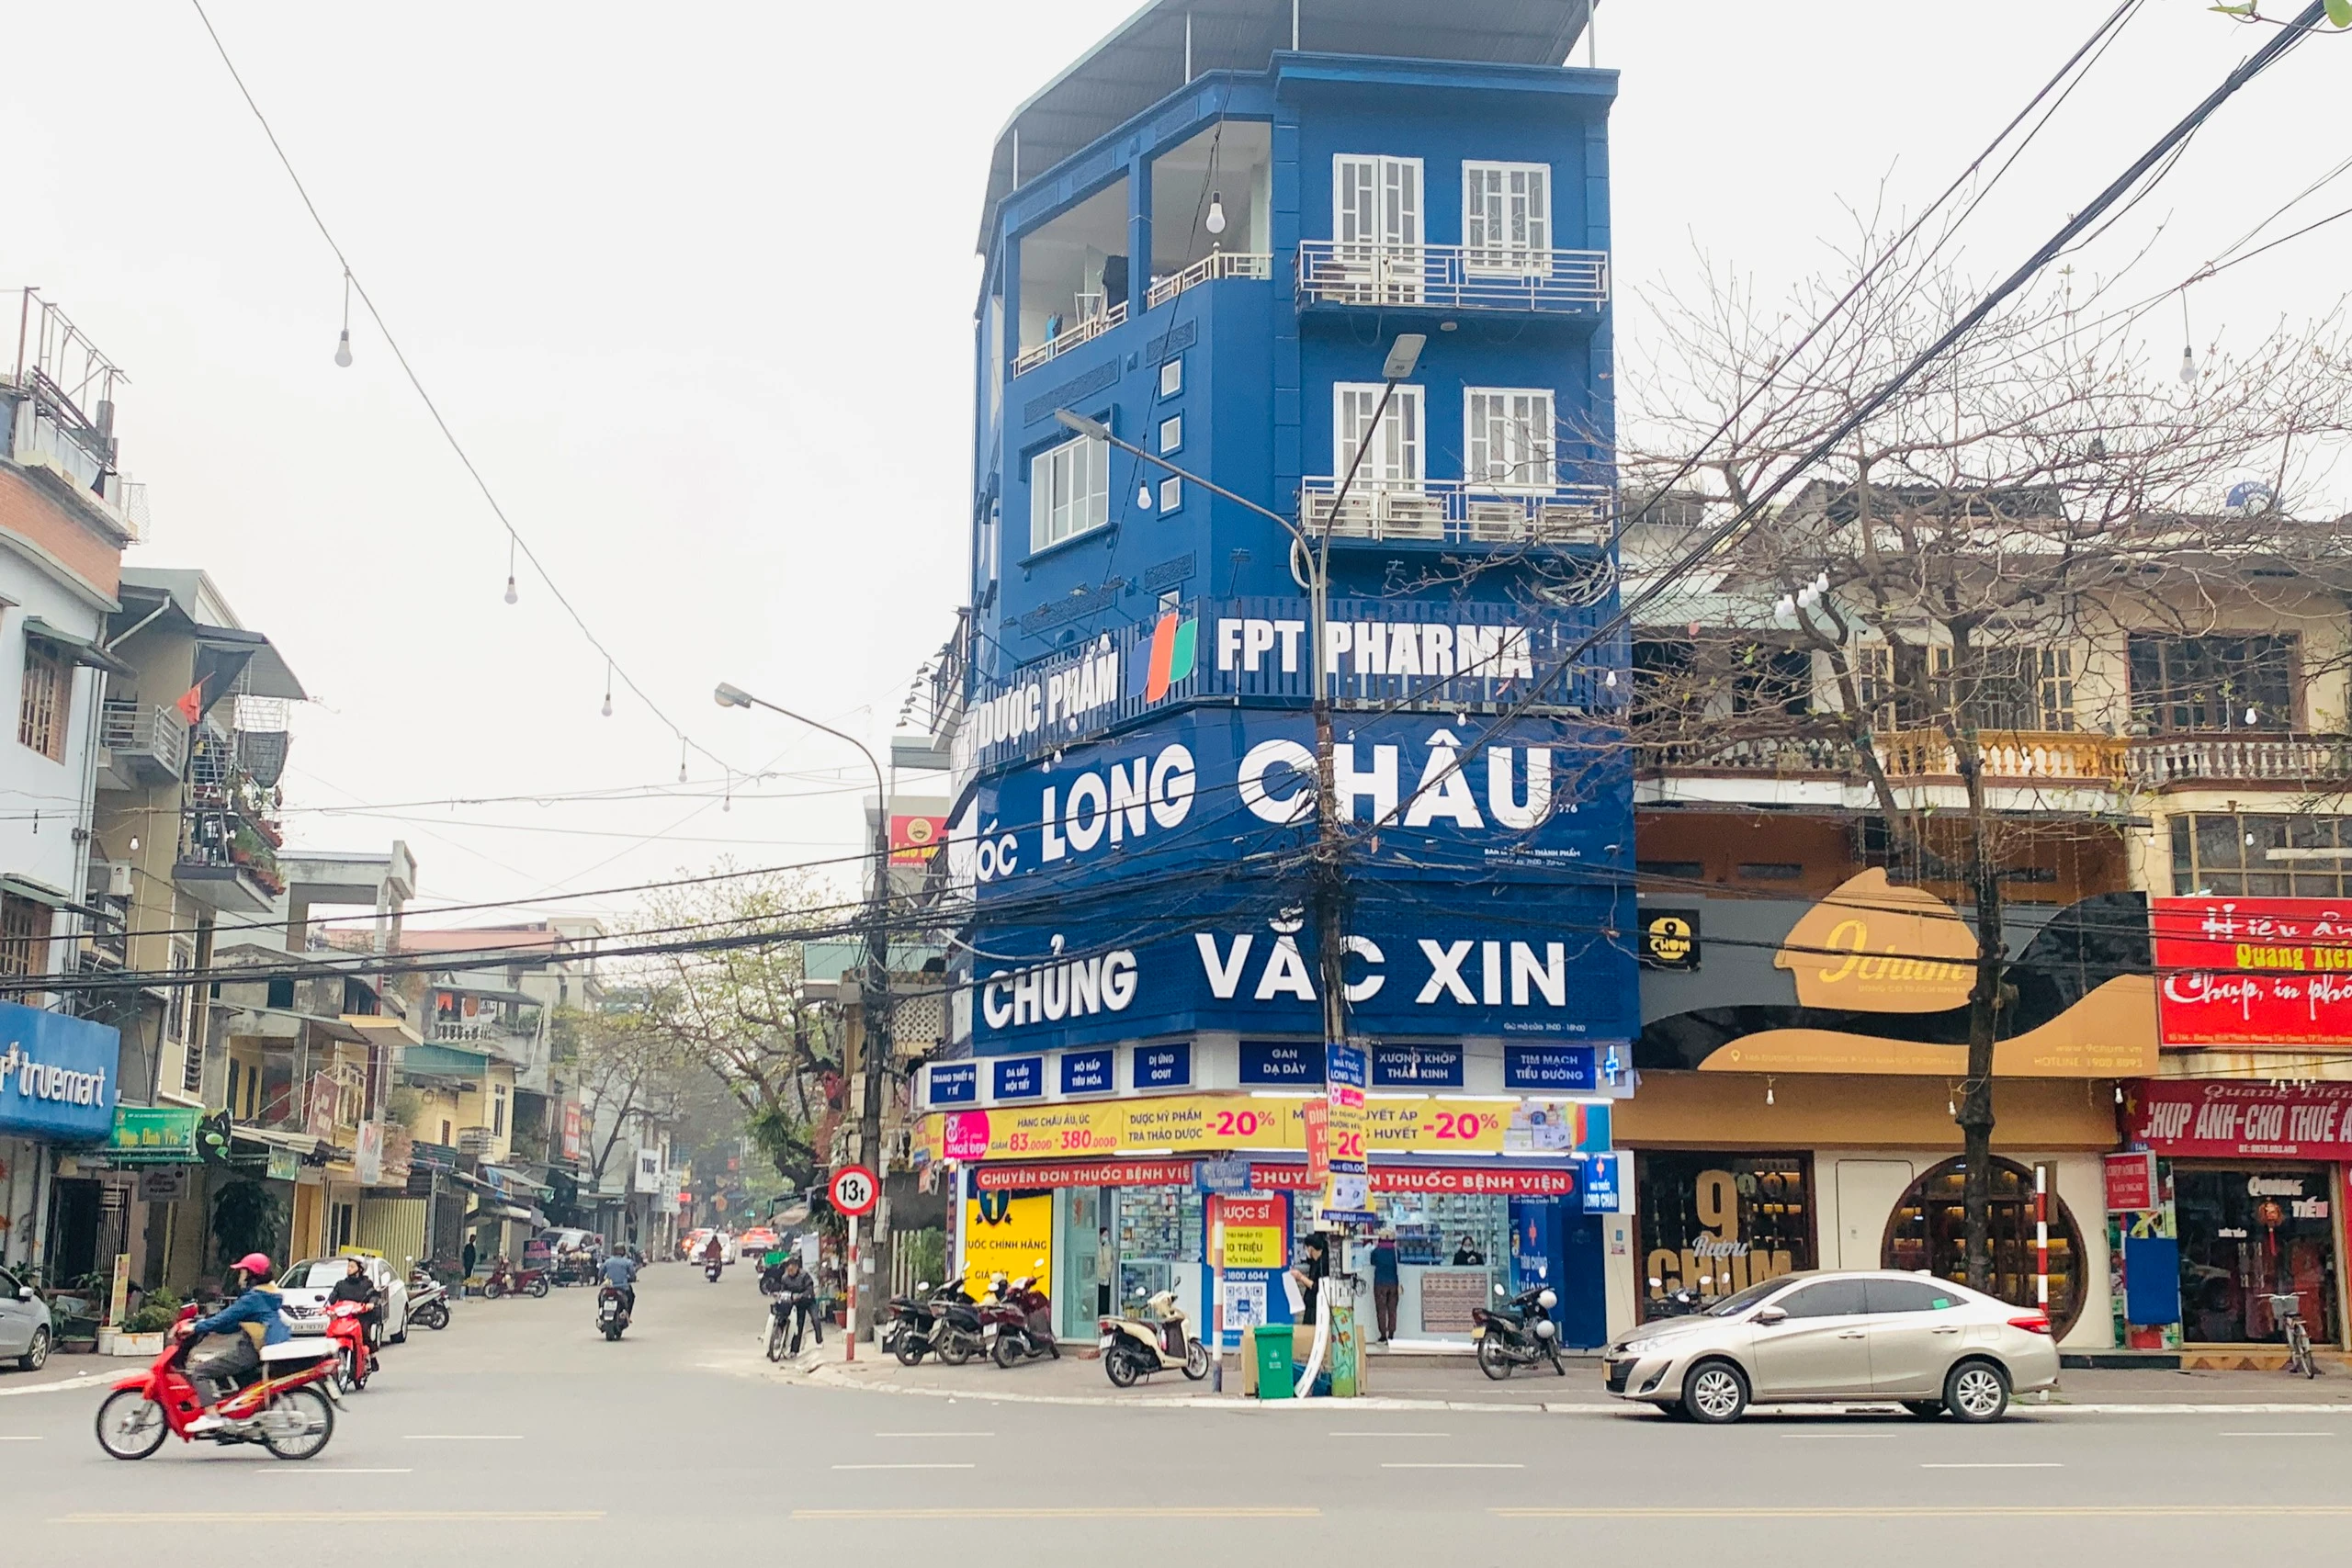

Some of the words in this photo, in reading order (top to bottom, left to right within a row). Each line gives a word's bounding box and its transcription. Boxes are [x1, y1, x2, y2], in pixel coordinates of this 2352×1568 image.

[1217, 617, 1305, 672] FPT
[1325, 620, 1534, 680] PHARMA
[978, 681, 1041, 749] DƯỢC
[1042, 743, 1196, 863] LONG
[1238, 728, 1553, 829] CHÂU
[2201, 903, 2301, 942] Hiệu
[2235, 942, 2306, 971] Quang
[982, 933, 1138, 1030] CHỦNG
[1415, 939, 1566, 1007] XIN
[2272, 977, 2301, 999] in
[1148, 1055, 1158, 1067] DỊ
[1158, 1051, 1174, 1065] ỨNG
[1272, 1048, 1298, 1060] GAN
[1379, 1051, 1421, 1065] XƯƠNG
[1424, 1051, 1457, 1065] KHỚP
[1521, 1054, 1539, 1066] TIM
[1543, 1054, 1578, 1067] MẠCH
[932, 1072, 952, 1083] TRANG
[1151, 1068, 1171, 1080] GOUT
[1263, 1063, 1281, 1077] DẠ
[1283, 1060, 1307, 1075] DÀY
[1330, 1069, 1350, 1081] LONG
[1421, 1067, 1449, 1079] KINH
[1546, 1062, 1584, 1080] ĐƯỜNG
[18, 1051, 107, 1108] truemart
[2204, 1084, 2294, 1100] Quang
[1040, 1114, 1062, 1125] CHÂU
[1079, 1112, 1091, 1124] ÚC
[1130, 1110, 1155, 1124] DƯỢC
[1157, 1108, 1170, 1122] MỸ
[1172, 1105, 1203, 1121] PHẨM
[1205, 1110, 1276, 1137] -20%
[1400, 1108, 1419, 1122] ÁP
[2289, 1100, 2339, 1142] THUÊ
[1148, 1124, 1172, 1142] THẢO
[1174, 1127, 1203, 1142] DƯỢC
[1374, 1124, 1419, 1140] HUYẾT
[1423, 1111, 1499, 1141] -20%
[980, 1169, 1036, 1186] CHUYÊN
[1039, 1169, 1069, 1183] ĐƠN
[1072, 1163, 1122, 1181] THUỐC
[1125, 1164, 1163, 1181] BỆNH
[1166, 1162, 1192, 1181] VIỆ
[1385, 1170, 1456, 1189] THUỐC
[1462, 1174, 1514, 1192] BỆNH
[1520, 1174, 1566, 1192] VIỆN
[1584, 1193, 1600, 1208] LONG
[1600, 1190, 1618, 1208] CHÂU
[1695, 1169, 1739, 1242] 9
[1258, 1203, 1271, 1219] SĨ
[989, 1236, 1018, 1249] CHÍNH
[1227, 1243, 1235, 1252] 10
[1238, 1243, 1263, 1254] TRIỆU
[975, 1268, 990, 1280] GIÁ
